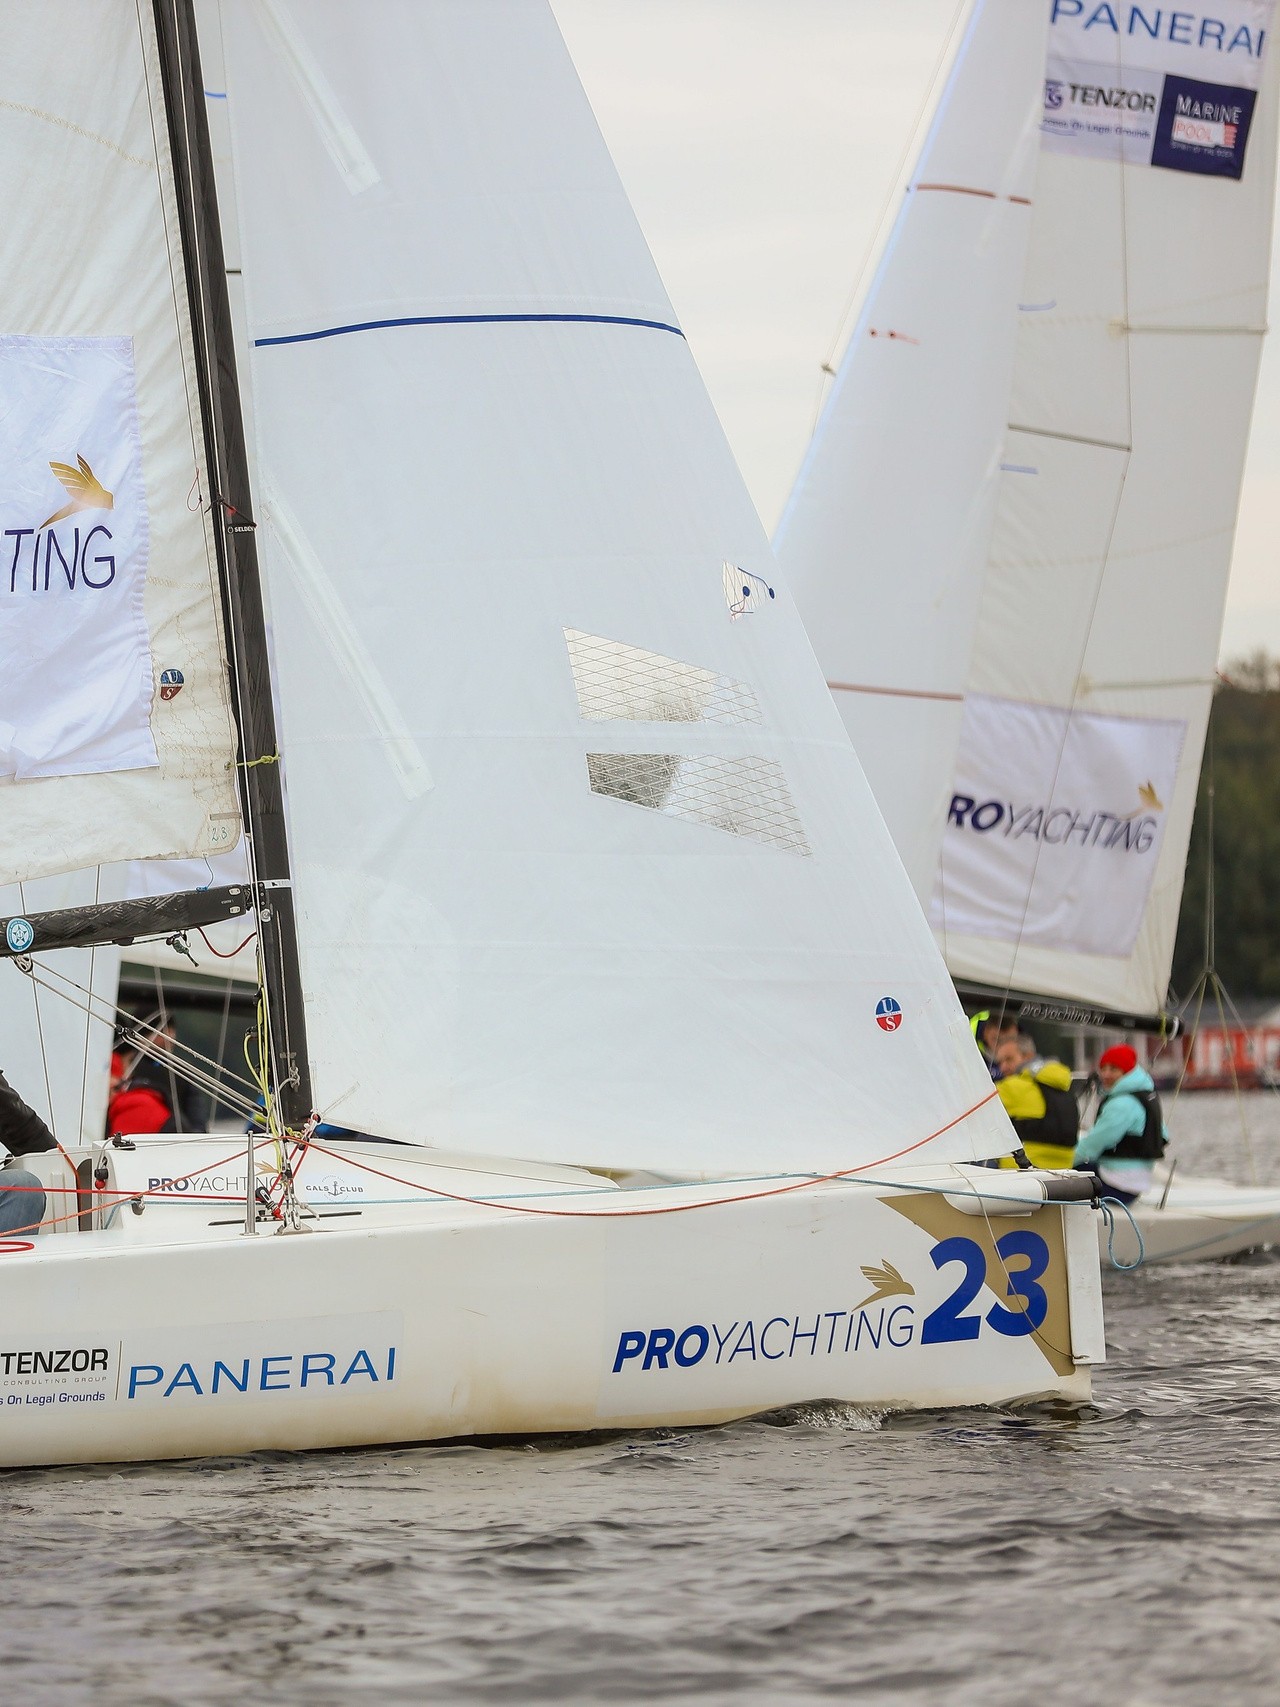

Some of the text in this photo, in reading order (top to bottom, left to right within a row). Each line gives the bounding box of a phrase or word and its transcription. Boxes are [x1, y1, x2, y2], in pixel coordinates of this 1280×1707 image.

[1050, 0, 1265, 57] PANERAI
[1068, 83, 1157, 114] TENZOR
[1176, 94, 1242, 124] MARINE
[947, 794, 1157, 854] ROYACHTING
[148, 1176, 283, 1192] PROYACHTNG
[921, 1230, 1050, 1345] 23
[611, 1304, 915, 1373] PROYACHTING
[0, 1348, 109, 1375] TENZOR
[127, 1347, 396, 1399] PANERAI
[3, 1378, 67, 1386] CONSULTING
[7, 1395, 22, 1405] On
[26, 1393, 56, 1407] Legal
[58, 1391, 106, 1403] Grounds
